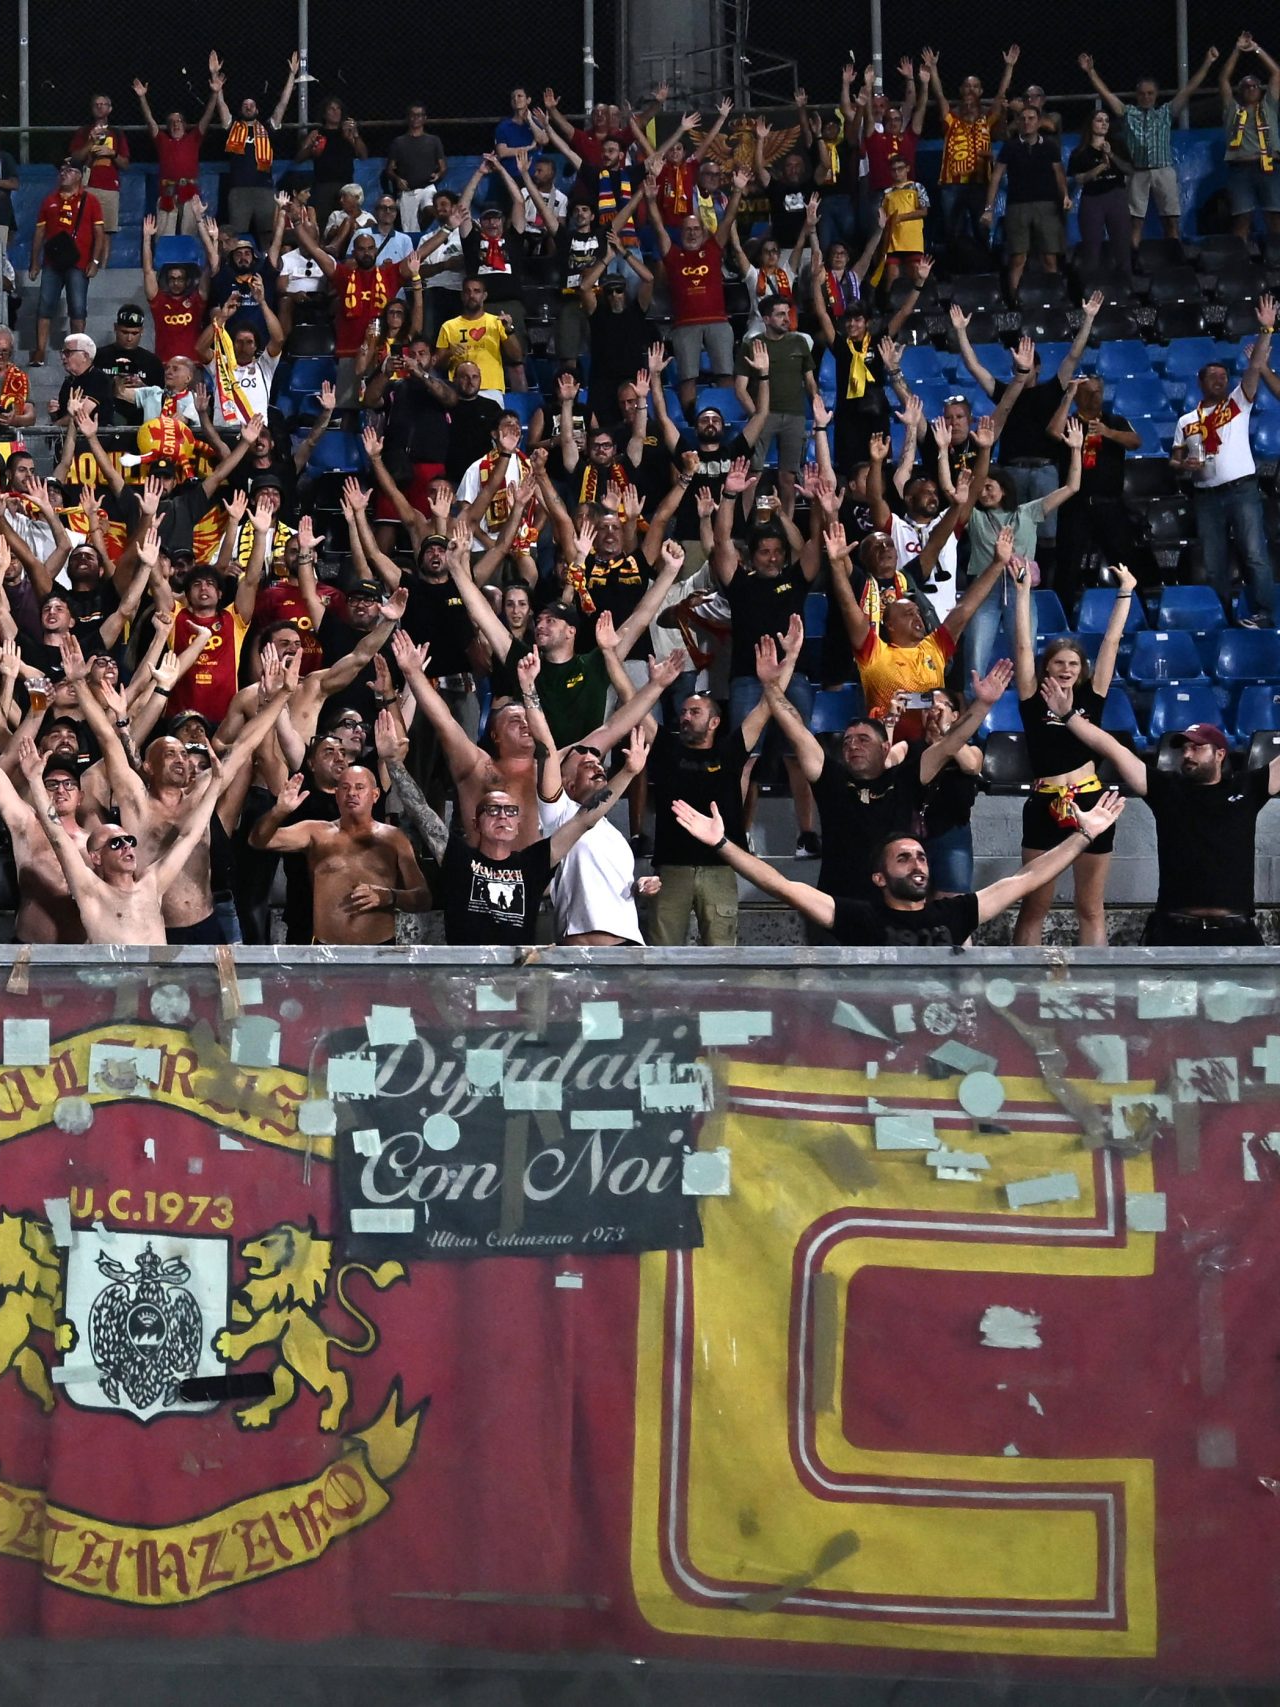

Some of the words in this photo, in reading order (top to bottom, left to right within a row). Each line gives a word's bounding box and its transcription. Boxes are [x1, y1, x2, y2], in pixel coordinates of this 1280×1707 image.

[164, 313, 192, 326] coop
[360, 1131, 504, 1204] Con
[523, 1126, 685, 1201] Noi
[486, 1231, 574, 1248] Catanzaro
[582, 1226, 626, 1244] 1973
